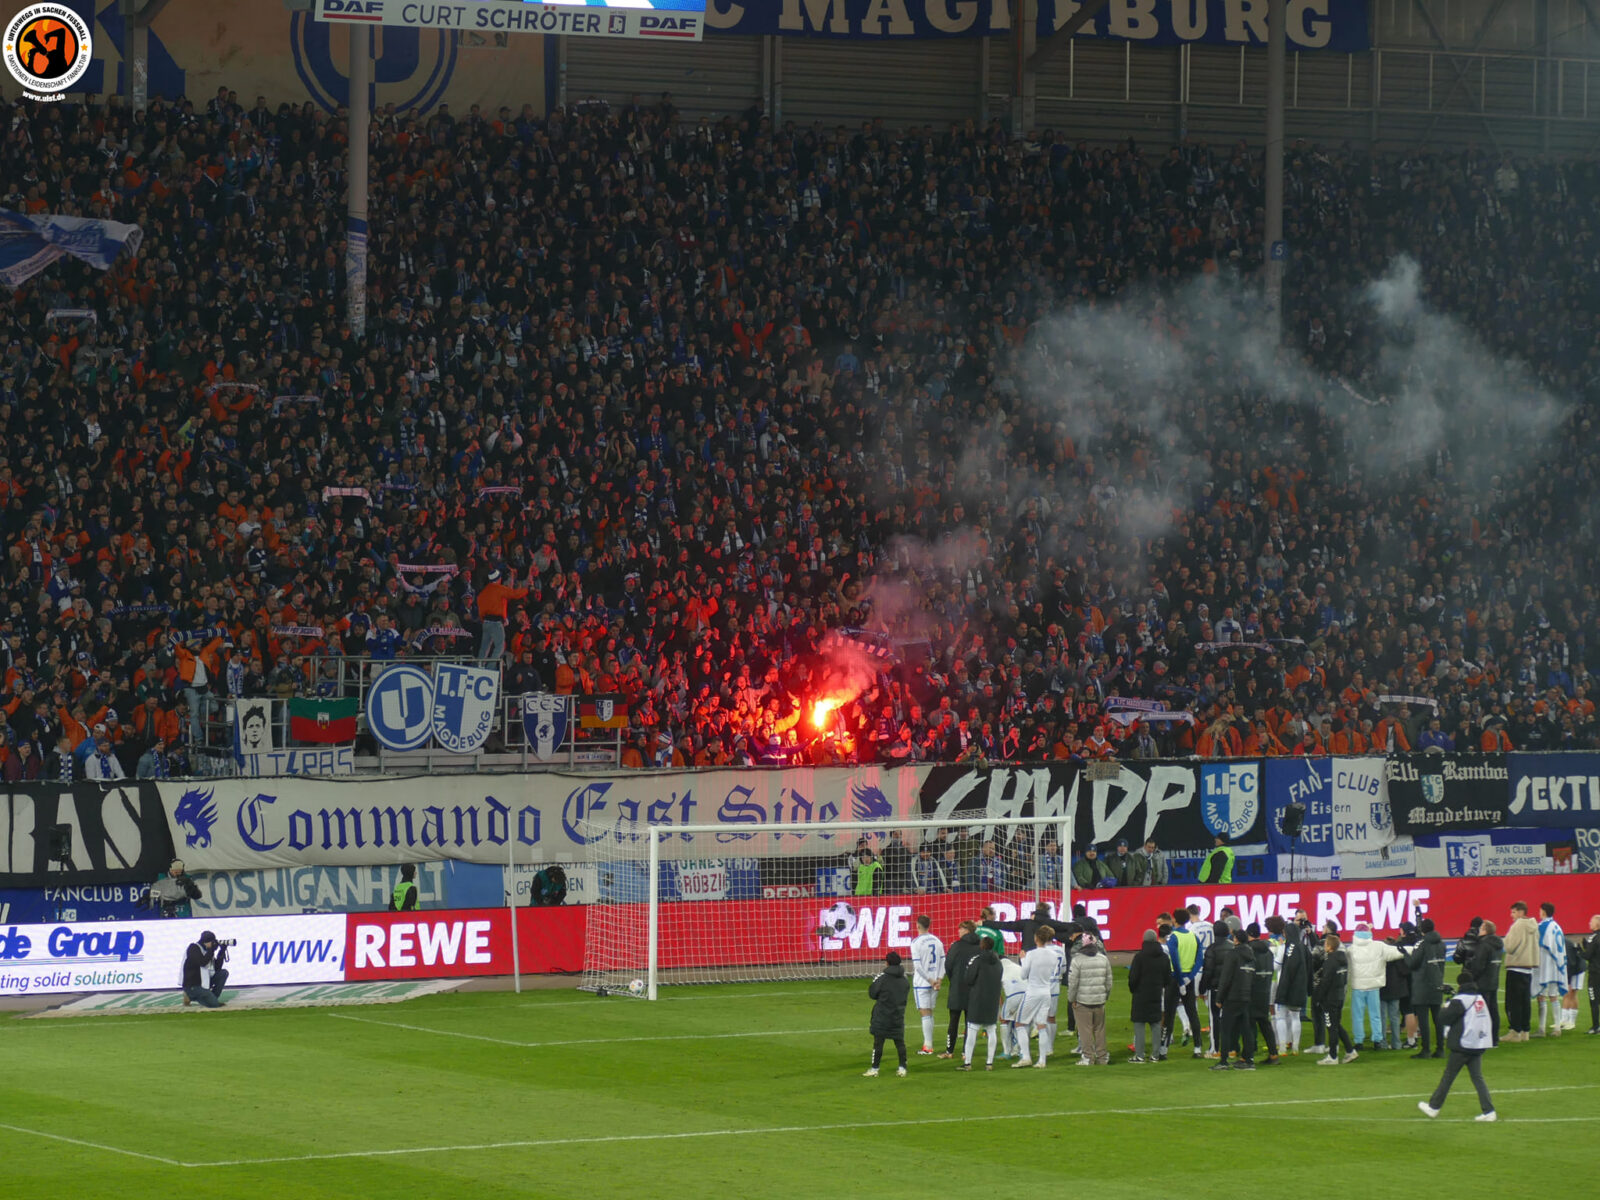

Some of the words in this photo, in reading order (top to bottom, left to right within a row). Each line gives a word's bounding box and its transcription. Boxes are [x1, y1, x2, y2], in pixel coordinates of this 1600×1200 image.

[323, 0, 384, 13] DAF
[402, 4, 466, 26] CURT
[475, 5, 601, 33] SCHRÖTER
[639, 16, 697, 30] DAF
[433, 704, 491, 749] MAGDEBURG
[1384, 760, 1419, 782] Elb
[1205, 772, 1255, 796] 1.FC
[236, 793, 541, 852] Commando
[562, 782, 698, 846] East
[716, 785, 840, 844] Side
[1207, 800, 1254, 834] MAGDEBURG
[1311, 801, 1351, 815] Eisern
[1407, 806, 1502, 827] Magdeburg
[1300, 822, 1367, 843] REFORM
[1496, 846, 1510, 854] FAN
[1513, 846, 1534, 854] CLUB
[44, 886, 123, 902] FANCLUB
[991, 900, 1111, 943] RE
[1317, 889, 1431, 933] REWE
[48, 926, 144, 961] Group
[354, 920, 492, 968] REWE
[928, 944, 937, 964] 3
[33, 971, 71, 987] solid
[74, 970, 143, 986] solutions
